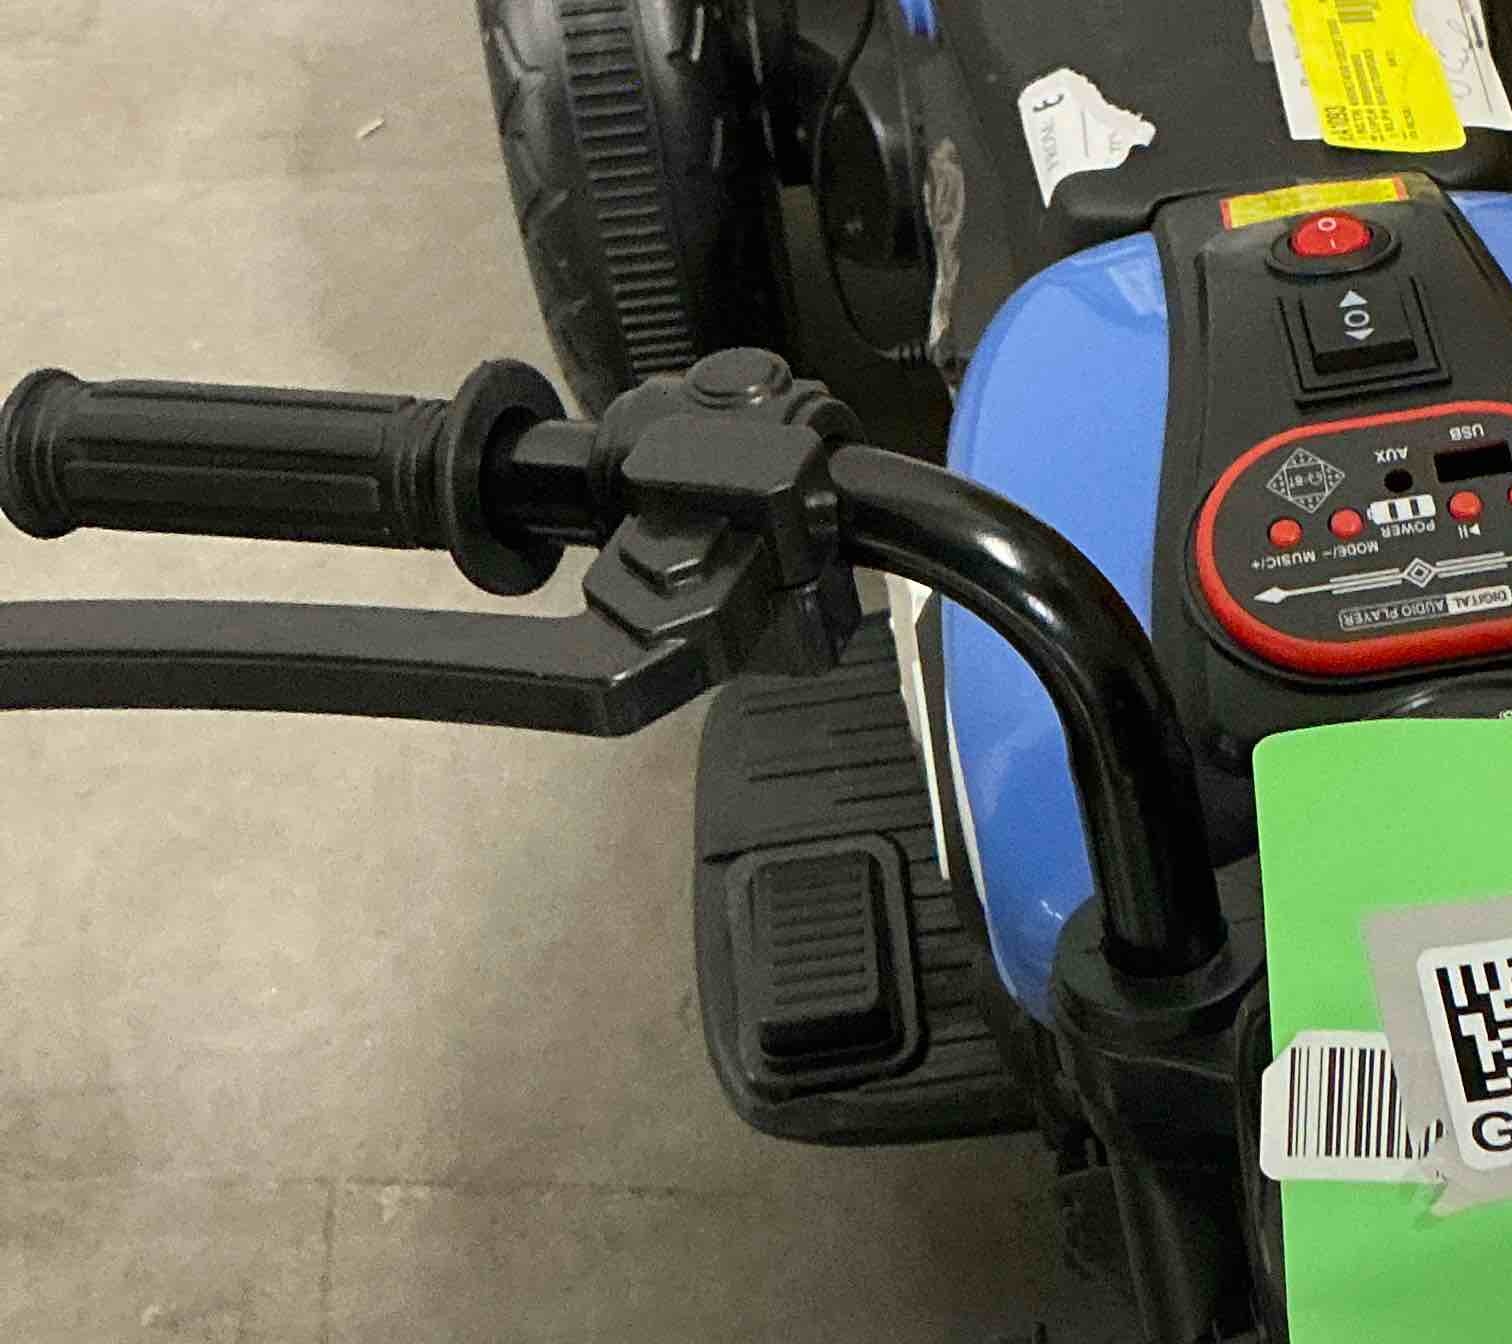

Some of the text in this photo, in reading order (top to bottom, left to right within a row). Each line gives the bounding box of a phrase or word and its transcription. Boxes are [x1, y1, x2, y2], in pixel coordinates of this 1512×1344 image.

[1448, 423, 1485, 441] USB
[1373, 445, 1409, 464] AUX
[1380, 520, 1437, 539] POWER
[1341, 604, 1401, 628] PLAYER
[1402, 598, 1446, 618] AUDIO
